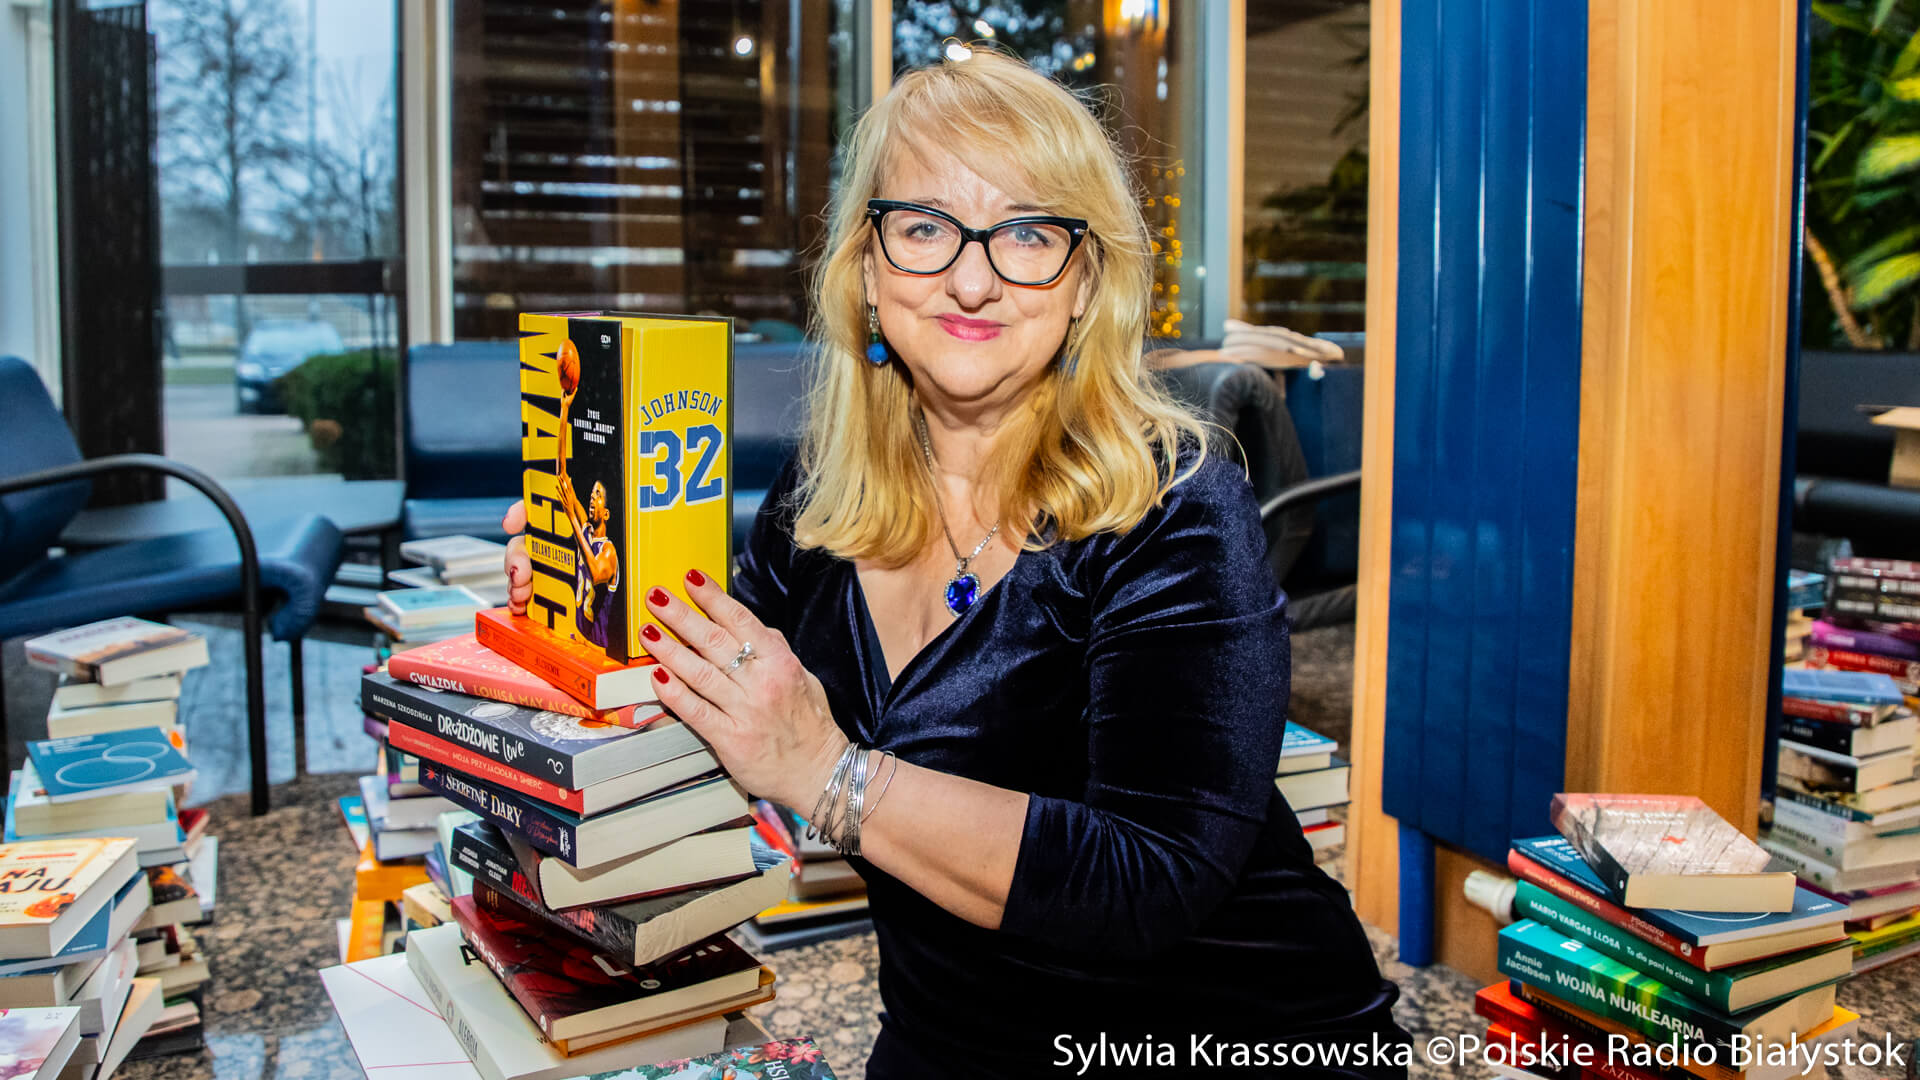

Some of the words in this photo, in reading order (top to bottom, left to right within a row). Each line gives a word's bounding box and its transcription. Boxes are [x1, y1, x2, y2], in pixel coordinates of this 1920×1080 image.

[640, 390, 723, 425] JOHNSON
[519, 313, 578, 646] MAGIC
[639, 423, 726, 513] 32
[372, 693, 397, 710] MARZENA
[409, 671, 466, 693] GWIAZDKA
[473, 684, 515, 702] LOUISA
[518, 694, 543, 708] MAY
[451, 751, 469, 765] MOJA
[445, 772, 488, 810] SEKRETNE
[490, 794, 523, 828] DARY
[1529, 899, 1558, 919] MARIO
[1558, 912, 1593, 936] VARGAS
[1593, 929, 1621, 950] LLOSA
[1505, 956, 1551, 984] Jacobsen
[1514, 949, 1543, 969] Annie
[1555, 969, 1606, 1003] WOJNA
[1609, 991, 1706, 1043] NUKLEARNA
